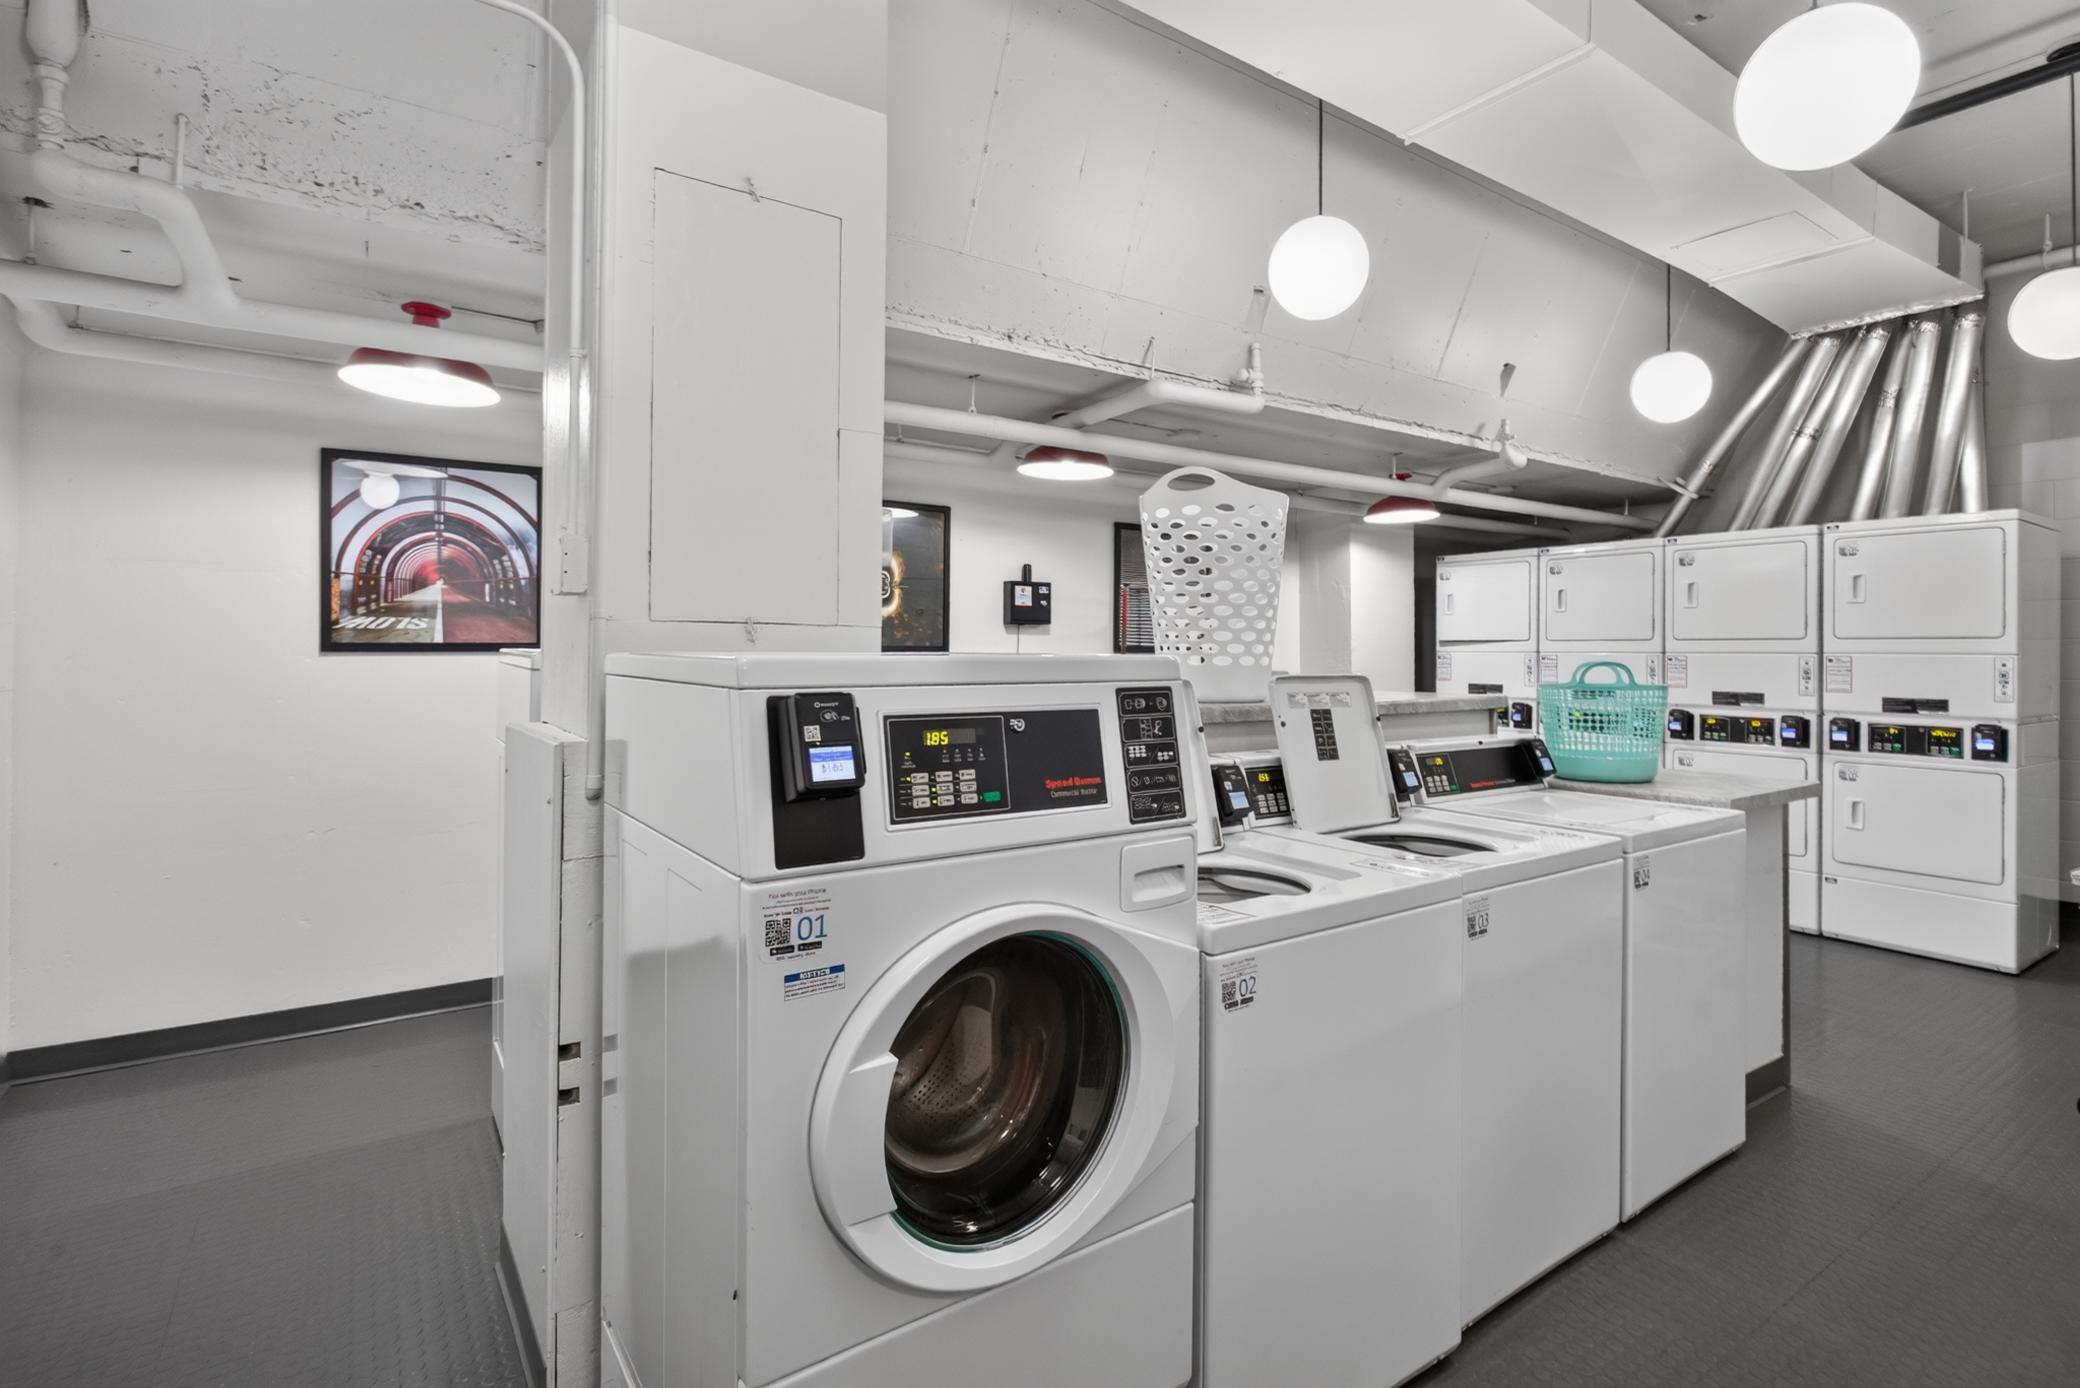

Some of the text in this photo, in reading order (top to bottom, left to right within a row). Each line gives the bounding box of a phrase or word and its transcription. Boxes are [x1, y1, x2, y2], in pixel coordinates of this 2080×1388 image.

[1043, 776, 1102, 790] Speed Queen
[797, 914, 828, 941] 01
[1238, 976, 1257, 998] 02
